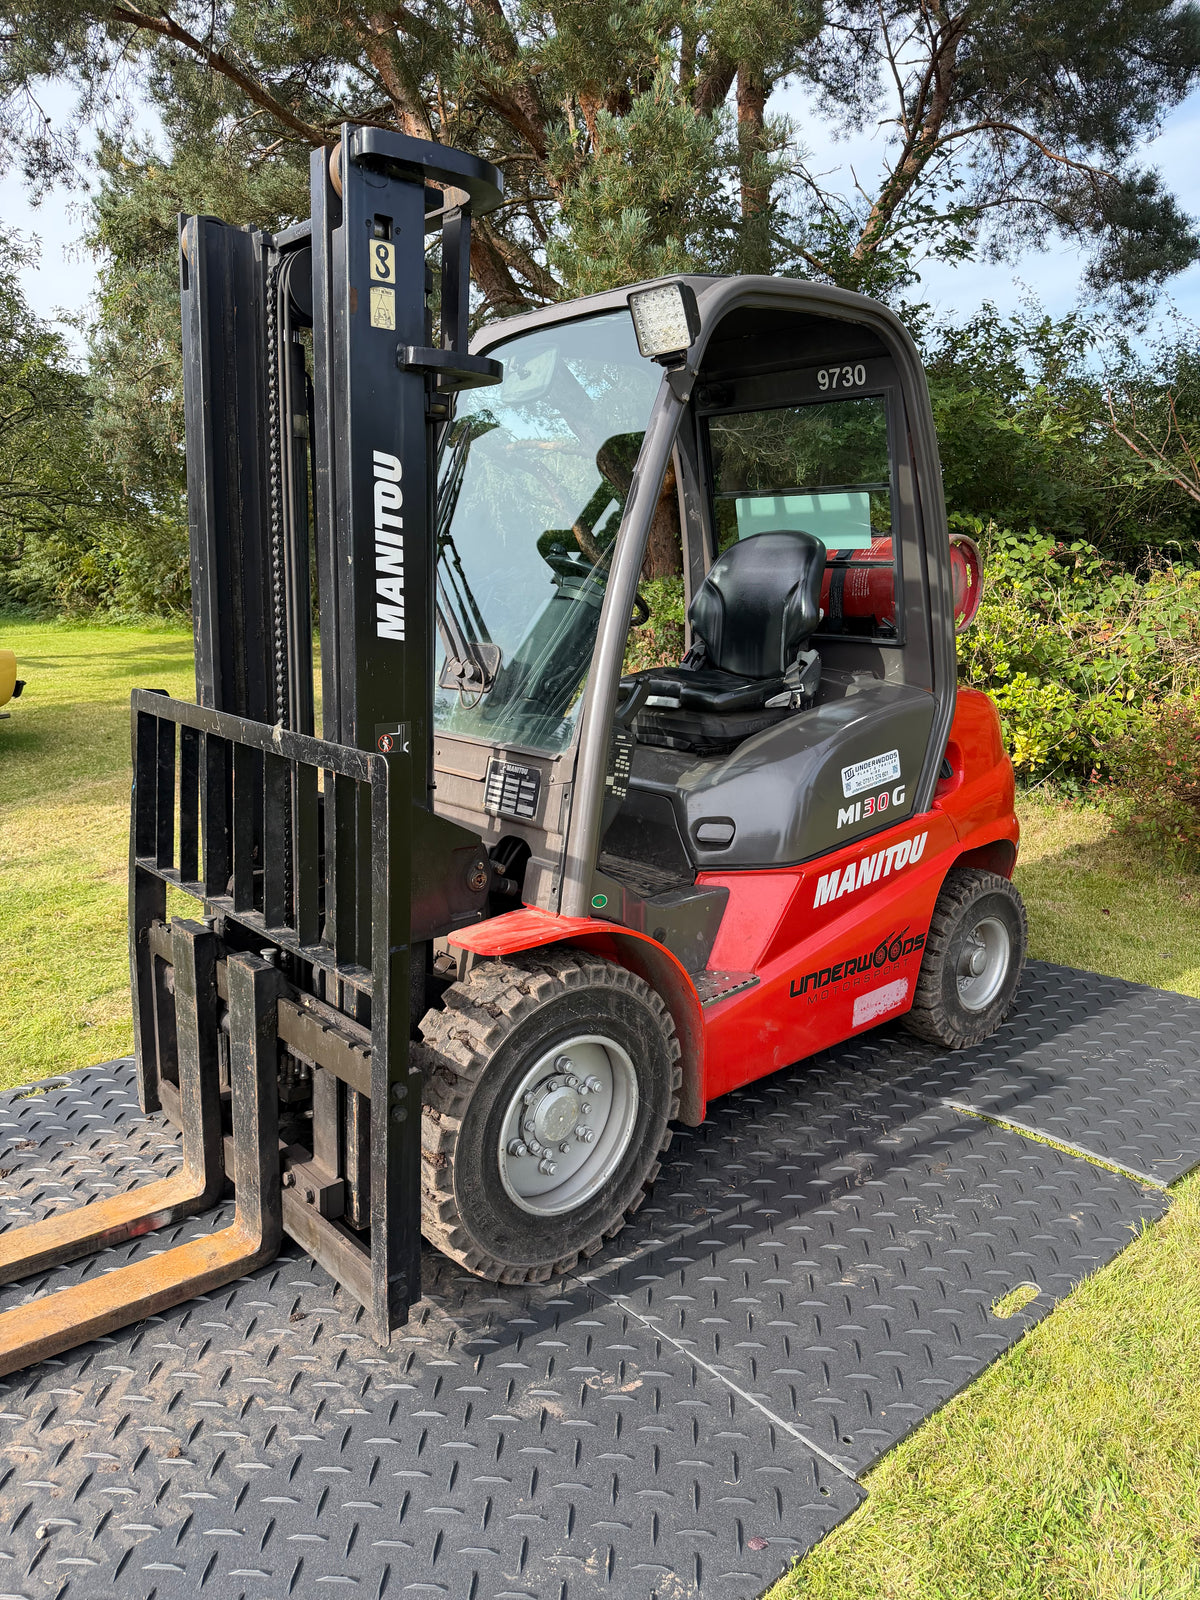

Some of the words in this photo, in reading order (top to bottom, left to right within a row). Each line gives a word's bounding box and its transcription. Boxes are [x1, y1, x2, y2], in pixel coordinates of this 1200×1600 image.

[817, 364, 866, 391] 9730
[373, 450, 405, 641] MANITOU
[505, 764, 529, 776] MANITOU
[855, 752, 898, 773] UNDERWOODS
[813, 831, 929, 909] MANITOU
[789, 925, 926, 998] UNDERWOODS
[807, 958, 909, 1006] MOTORSPORT
